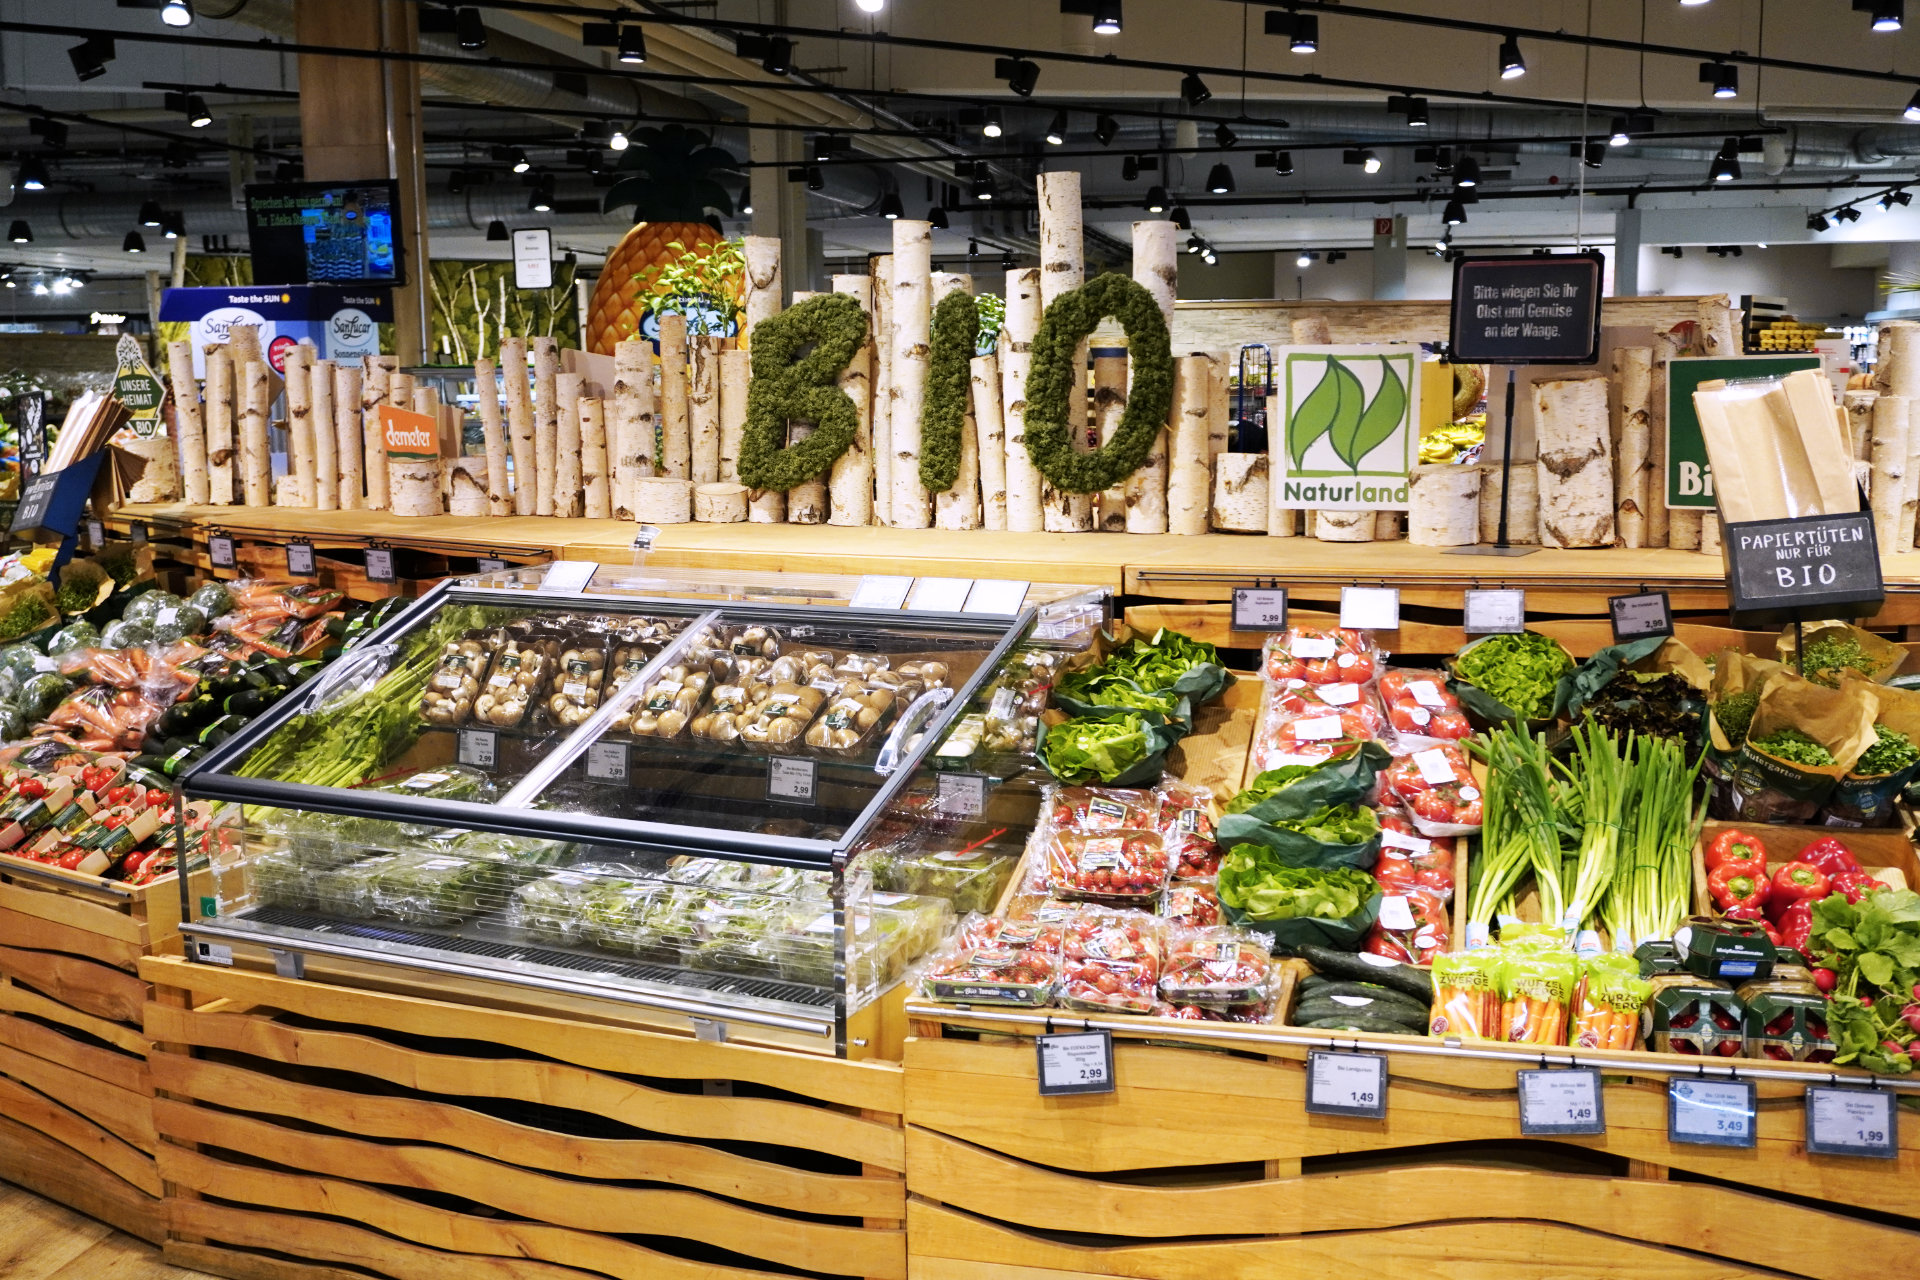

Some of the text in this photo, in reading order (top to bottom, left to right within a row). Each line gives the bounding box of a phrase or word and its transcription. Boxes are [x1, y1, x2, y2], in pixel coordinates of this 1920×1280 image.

[1473, 283, 1579, 301] Bitte wiegen Sie ihr
[228, 294, 281, 303] Taste the SUN
[1476, 303, 1573, 319] Obst und Gemüse
[334, 315, 371, 340] SanLucar
[1484, 323, 1561, 340] an der Waage.
[120, 379, 151, 391] UNSERE
[737, 272, 1174, 495] BIO
[123, 393, 152, 405] HEIMAT
[136, 421, 152, 434] BIO
[386, 419, 430, 447] demeter
[1285, 481, 1408, 502] Naturland
[22, 504, 39, 519] BIO
[1741, 526, 1863, 550] PAPIERTÜTEN
[1776, 545, 1832, 560] NUR FÜR
[1776, 563, 1836, 588] BIO
[1645, 619, 1663, 628] 2,99
[479, 755, 492, 763] 2,99
[609, 768, 623, 776] 2,99
[793, 785, 809, 794] 2,99
[1080, 1068, 1102, 1079] 2,99
[1350, 1092, 1374, 1103] 1,49
[1567, 1108, 1591, 1119] 1,49
[1717, 1119, 1743, 1131] 3,49
[1857, 1130, 1884, 1142] 1,99
